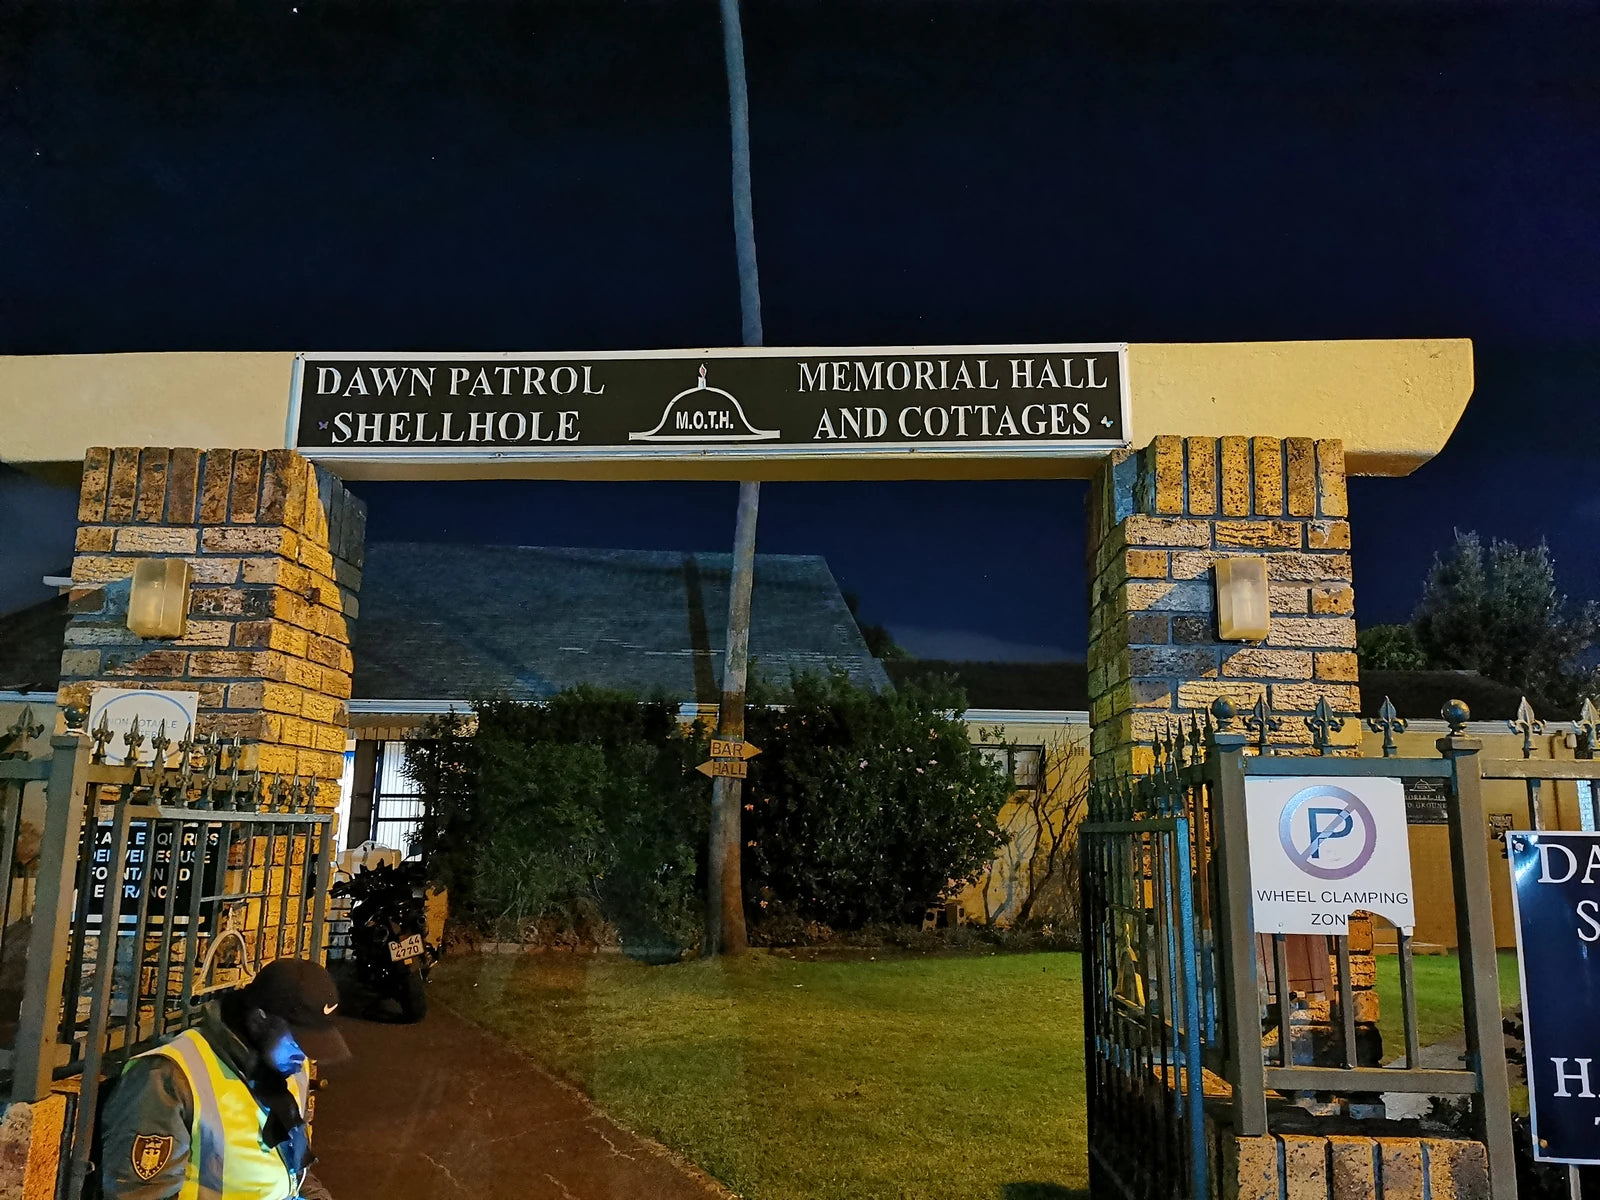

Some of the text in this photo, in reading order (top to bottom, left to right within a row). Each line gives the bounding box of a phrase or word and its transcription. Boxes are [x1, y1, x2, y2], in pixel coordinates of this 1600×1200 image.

[316, 365, 605, 397] DAWN PATROL
[798, 357, 1108, 393] MEMORIAL HALL
[331, 410, 581, 444] SHELLHOLE
[676, 410, 734, 430] M.O.T.H.
[813, 403, 1091, 440] AND COTTAGES
[712, 742, 743, 756] BAR
[713, 762, 746, 775] HALL
[1257, 890, 1409, 904] WHEEL CLAMPING
[1311, 913, 1351, 926] ZON
